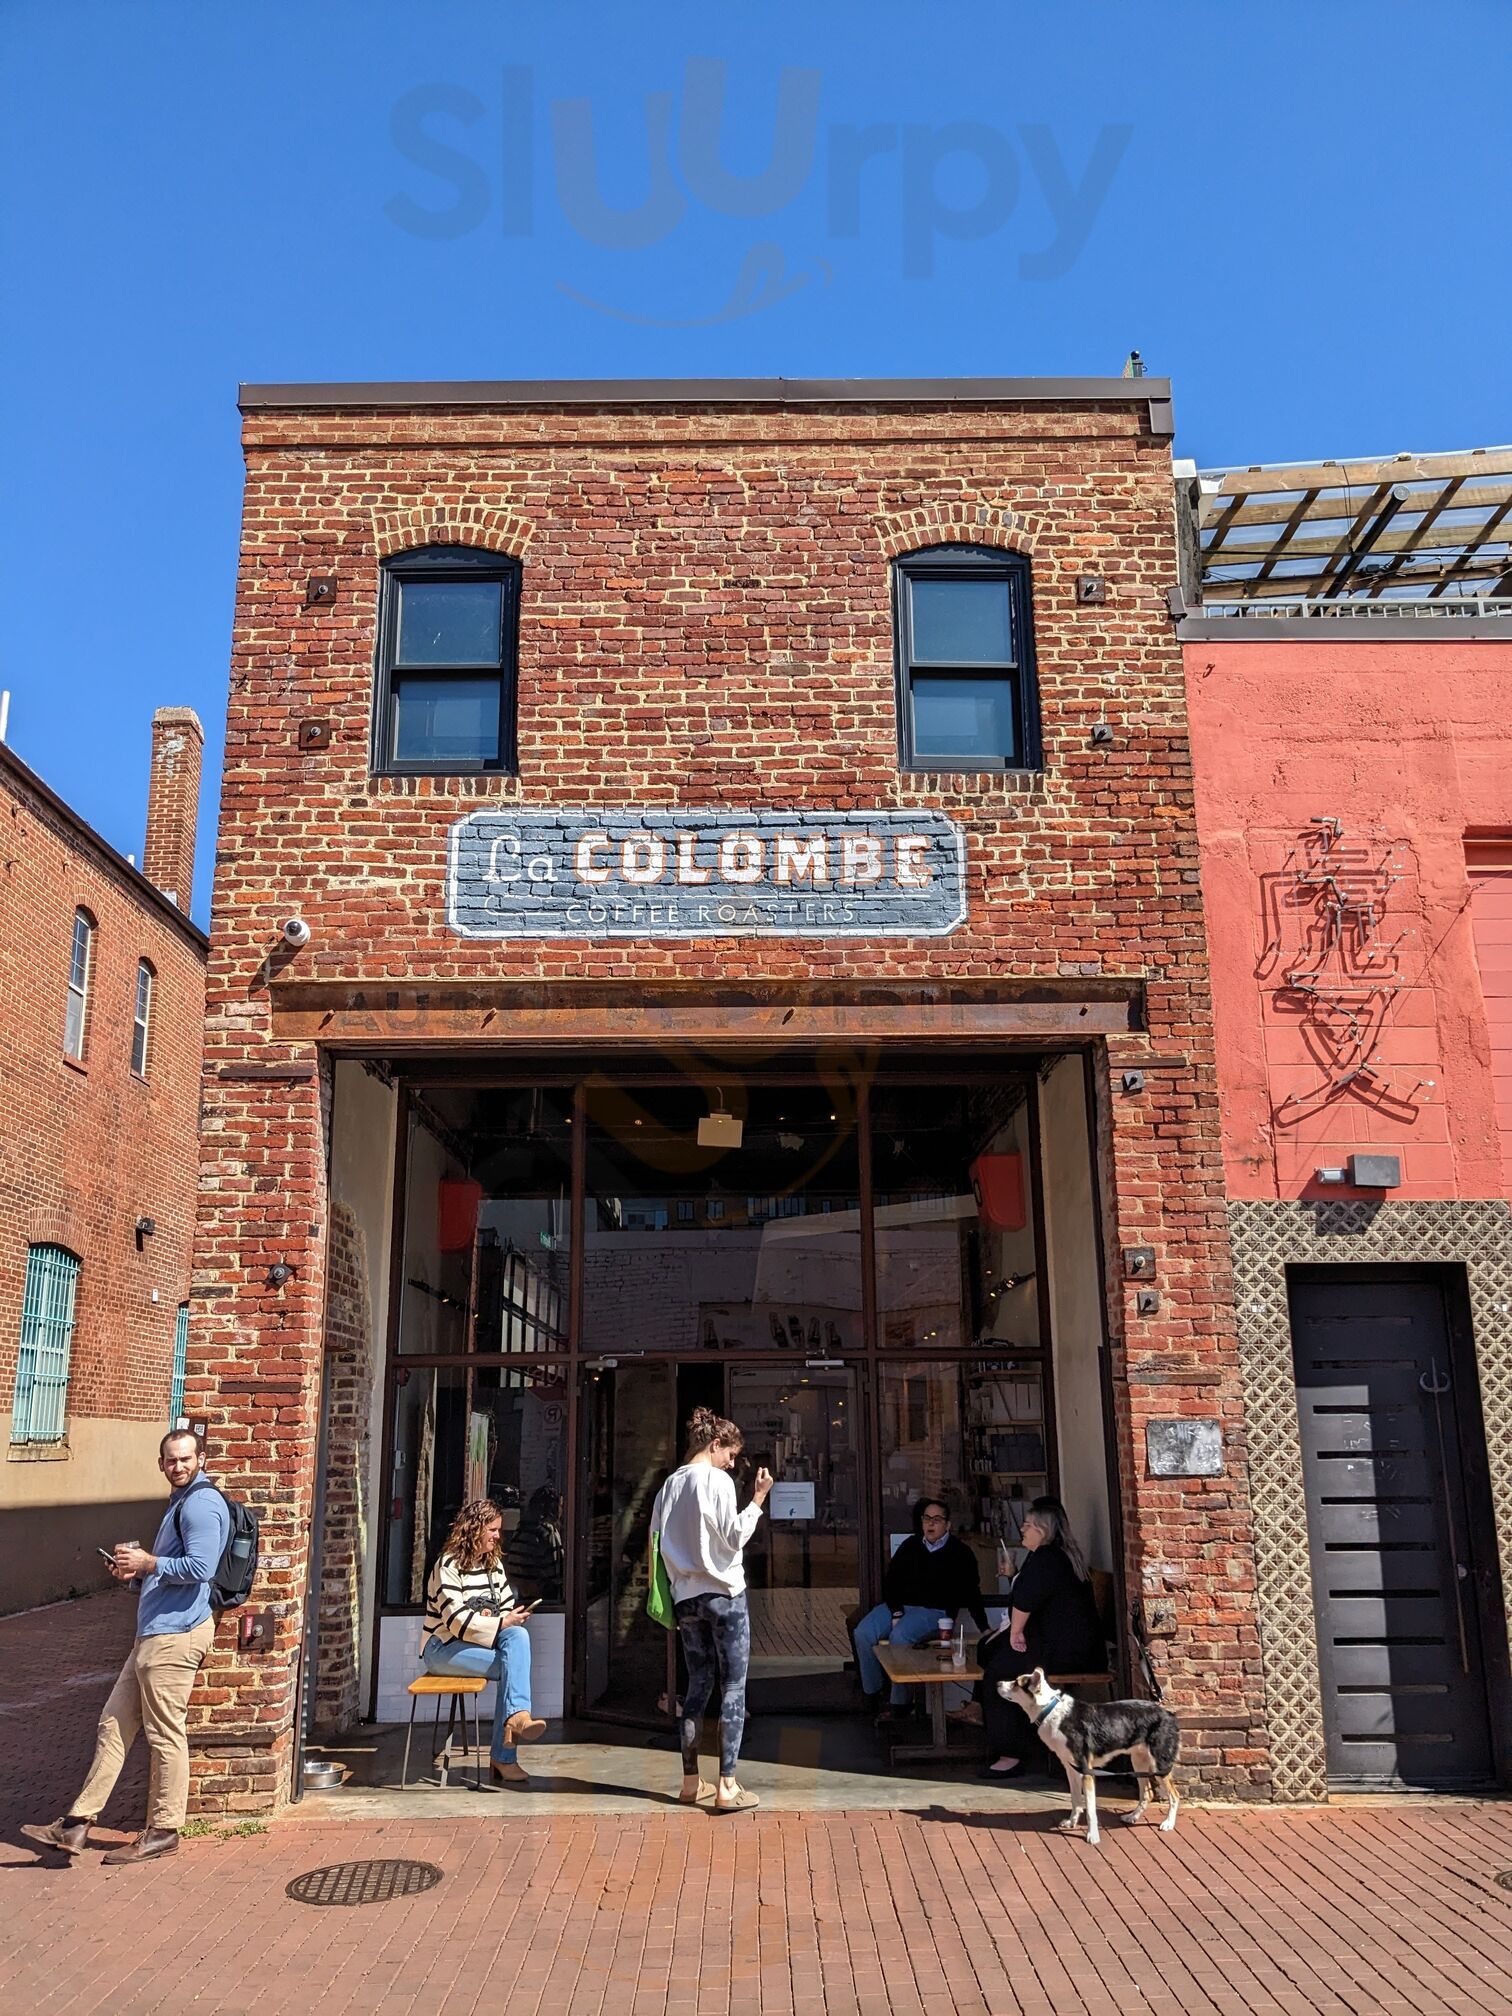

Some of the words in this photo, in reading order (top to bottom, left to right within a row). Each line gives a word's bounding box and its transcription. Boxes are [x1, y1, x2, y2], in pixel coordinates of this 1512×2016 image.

[483, 834, 559, 884] La
[573, 831, 935, 886] COLOMBE
[565, 903, 681, 924] COFFEE
[697, 901, 856, 923] ROASTERS
